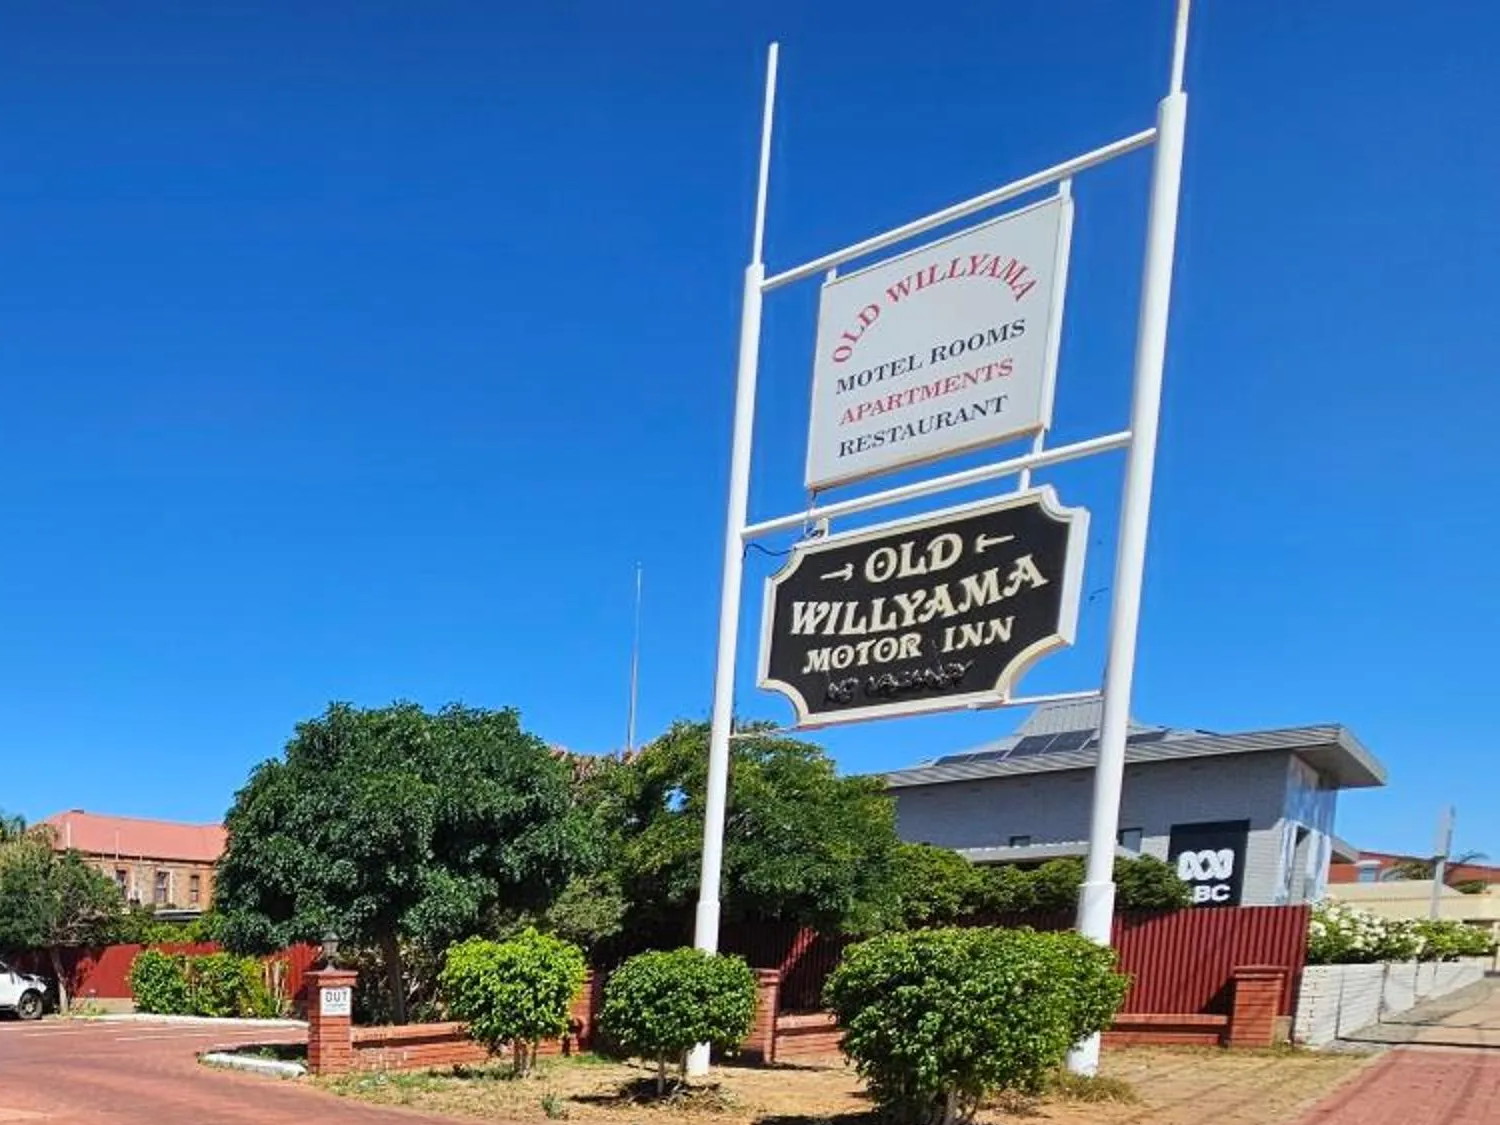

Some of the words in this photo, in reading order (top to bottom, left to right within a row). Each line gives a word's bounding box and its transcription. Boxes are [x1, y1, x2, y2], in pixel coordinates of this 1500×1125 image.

[832, 303, 880, 364] OLD
[885, 254, 1037, 302] WILLYAMA
[836, 355, 923, 395] MOTEL
[930, 319, 1026, 365] ROOMS
[838, 358, 1014, 426] APARTMENTS
[838, 395, 1008, 457] RESTAURANT
[864, 533, 963, 583] OLD
[790, 554, 1050, 636] WILLYAMA
[803, 633, 922, 674] MOTOR
[941, 616, 1016, 653] INN
[1189, 884, 1230, 903] BC
[325, 991, 347, 1002] OUT
